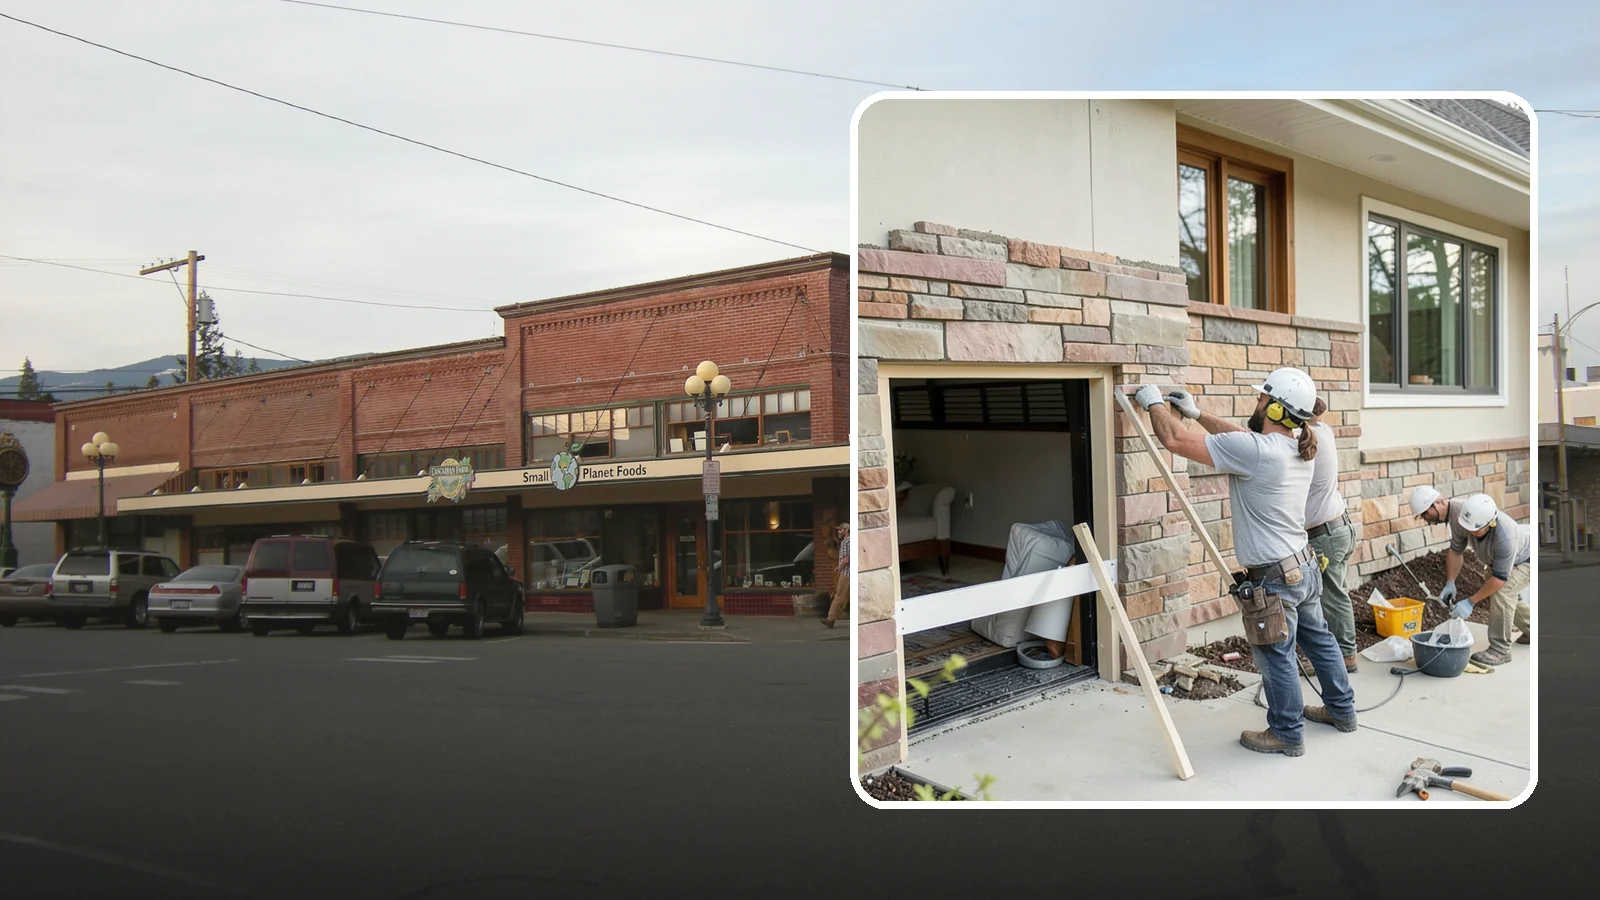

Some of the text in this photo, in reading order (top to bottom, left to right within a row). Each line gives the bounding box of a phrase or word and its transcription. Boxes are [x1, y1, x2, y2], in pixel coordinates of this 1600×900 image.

[523, 464, 647, 483] Small Planet Foods
